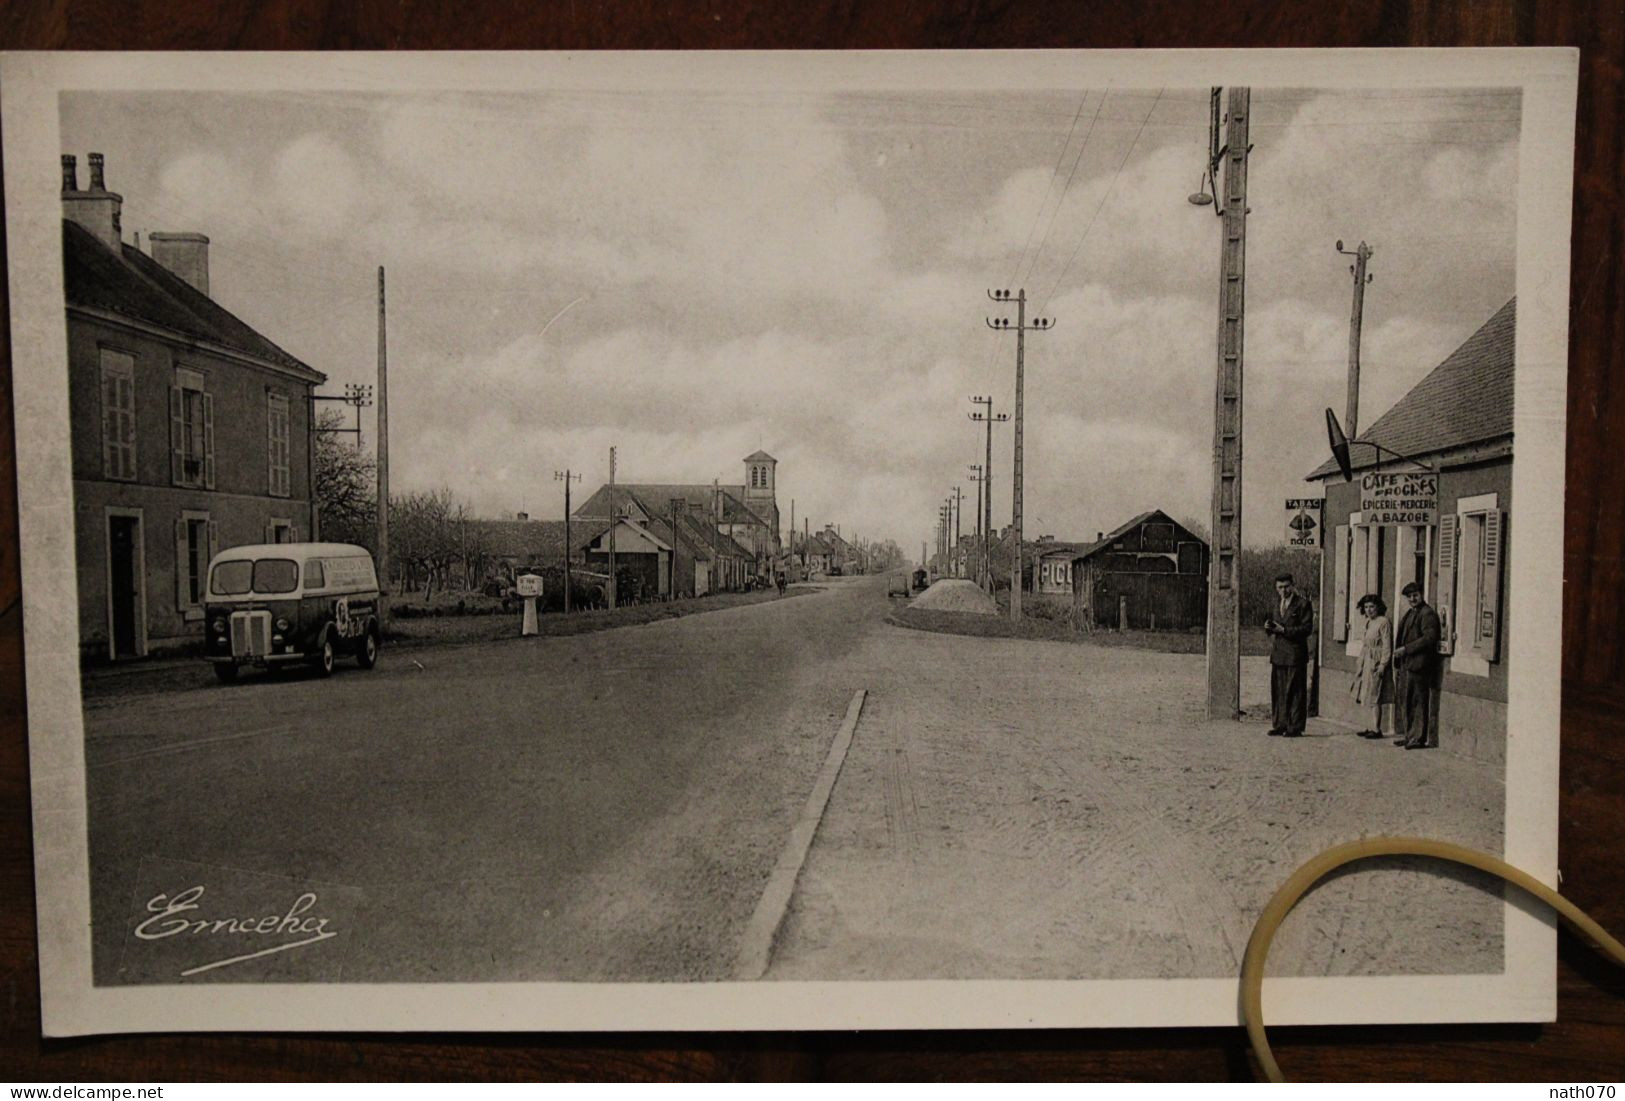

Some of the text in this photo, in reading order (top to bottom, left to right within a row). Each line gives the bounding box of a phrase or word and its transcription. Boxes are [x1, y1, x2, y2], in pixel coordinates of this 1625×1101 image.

[1287, 499, 1319, 507] TABAC
[1382, 512, 1430, 523] BAZOGE
[1290, 538, 1315, 546] naja
